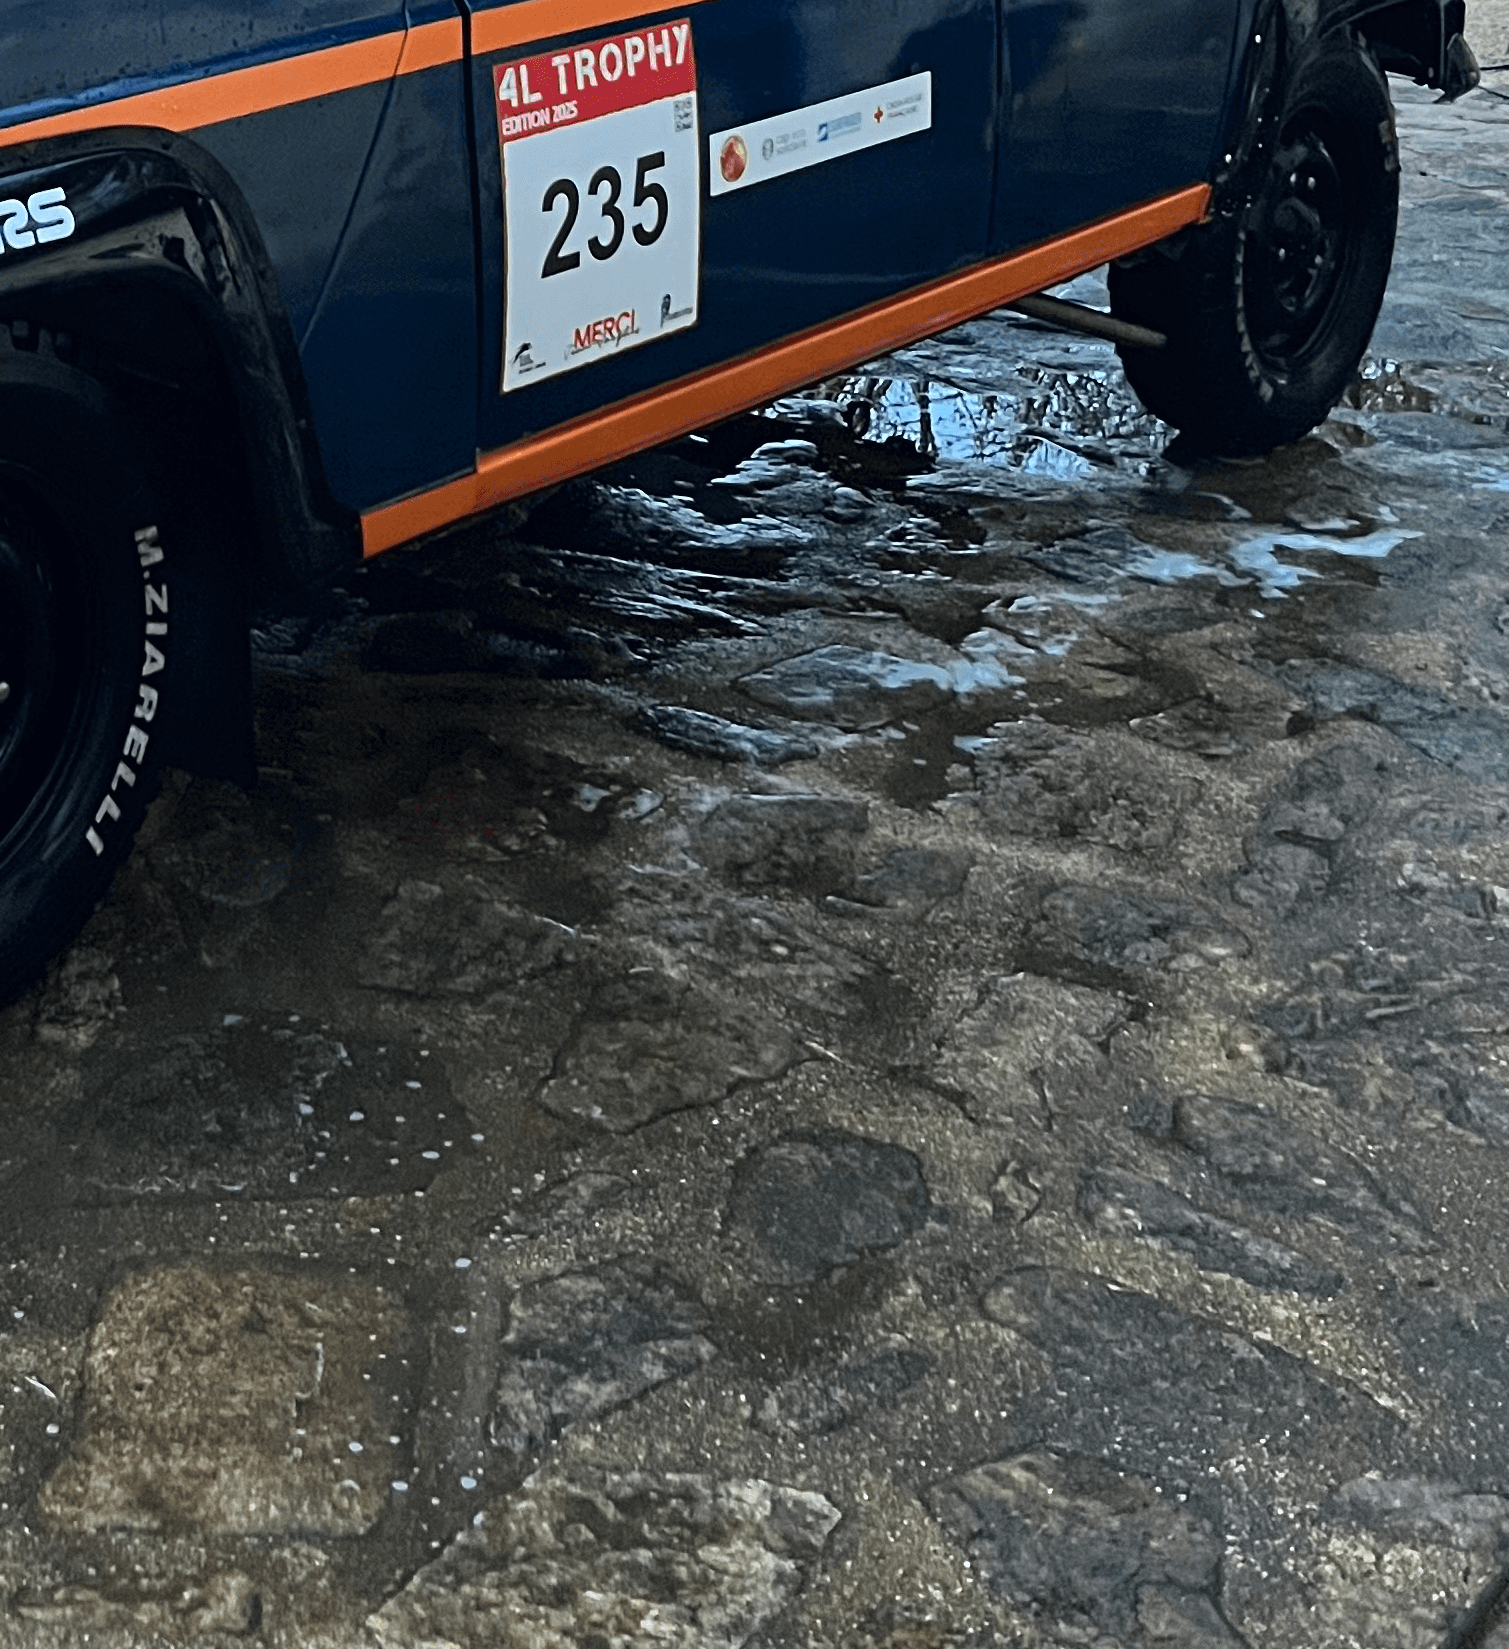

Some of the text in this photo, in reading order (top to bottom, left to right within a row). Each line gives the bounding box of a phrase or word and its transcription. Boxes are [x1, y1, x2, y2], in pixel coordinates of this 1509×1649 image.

[498, 23, 689, 108] 4L TROPHY
[502, 99, 579, 136] EDITION 2025
[540, 151, 669, 279] 235
